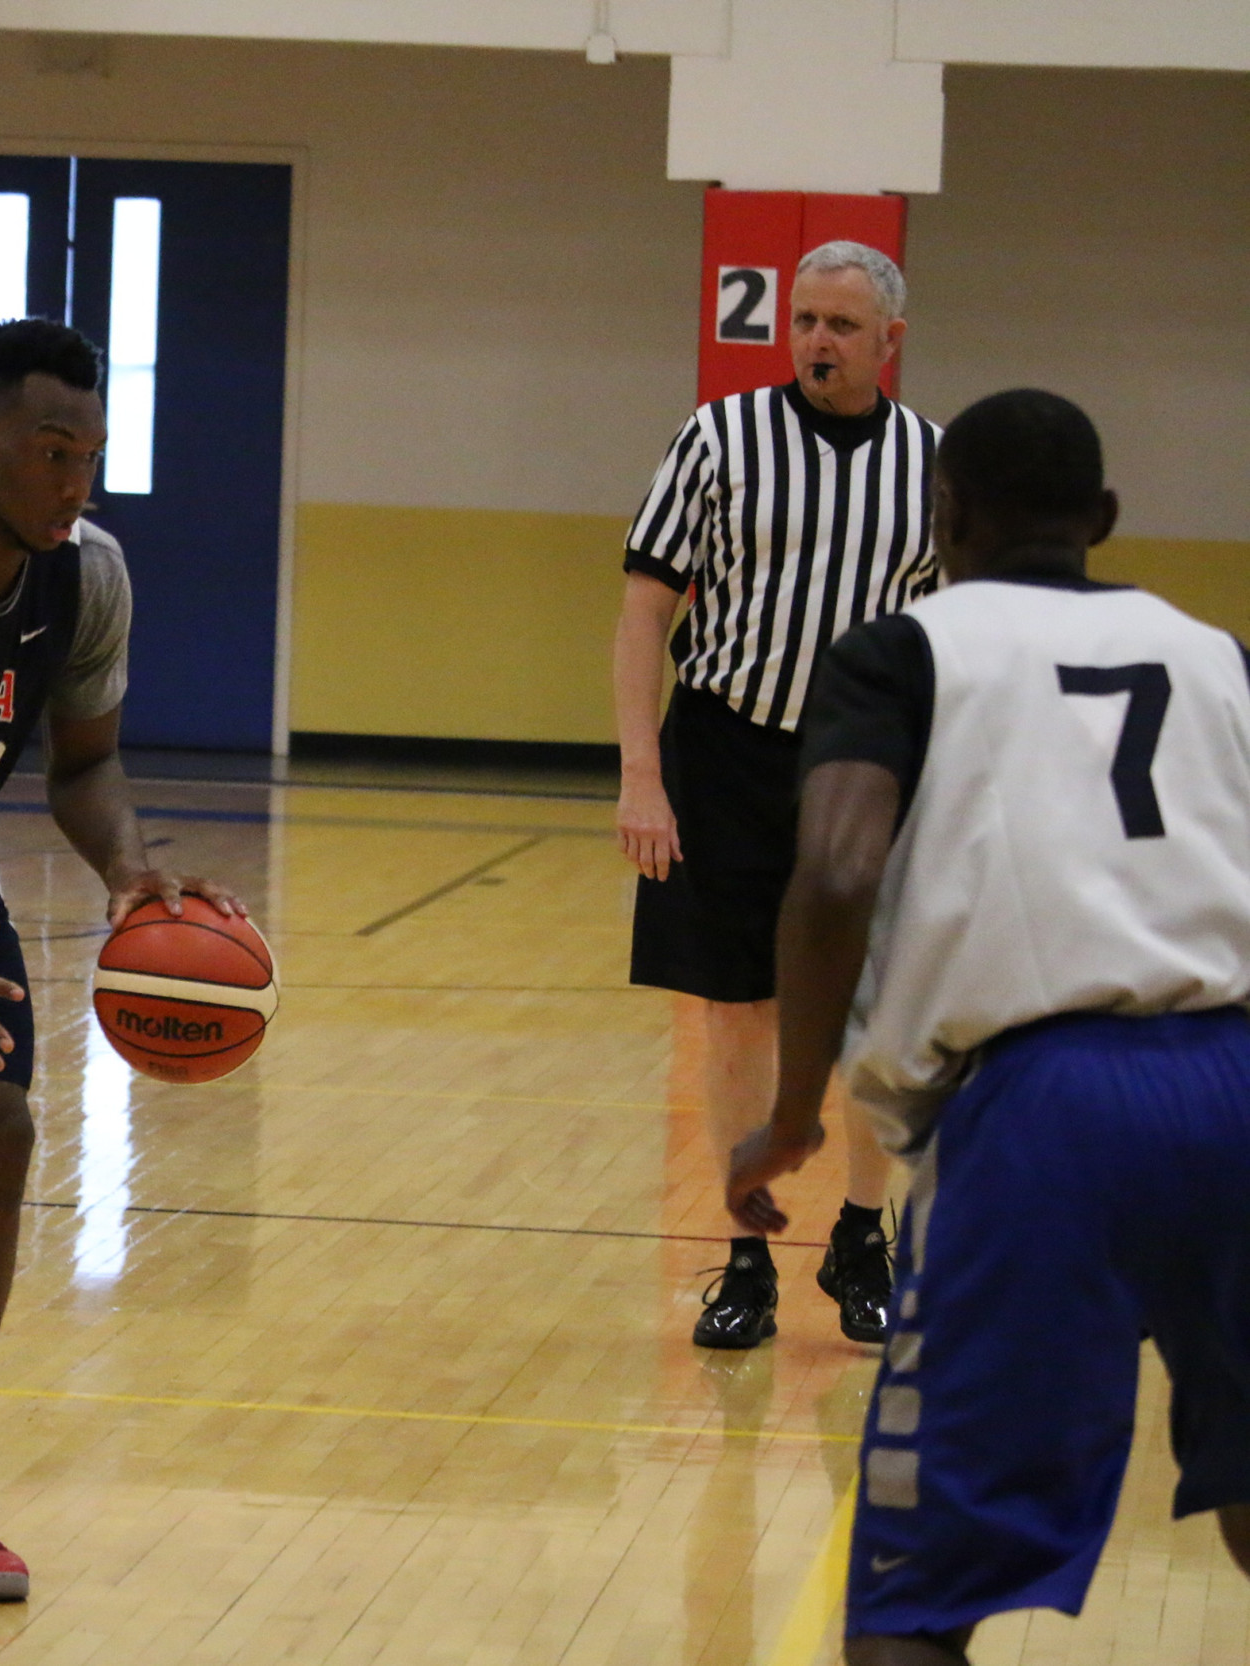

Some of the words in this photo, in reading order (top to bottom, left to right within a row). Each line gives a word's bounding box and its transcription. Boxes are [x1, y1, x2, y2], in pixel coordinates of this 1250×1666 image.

[720, 269, 769, 341] 2
[1055, 662, 1173, 839] 7
[117, 1009, 223, 1041] molten
